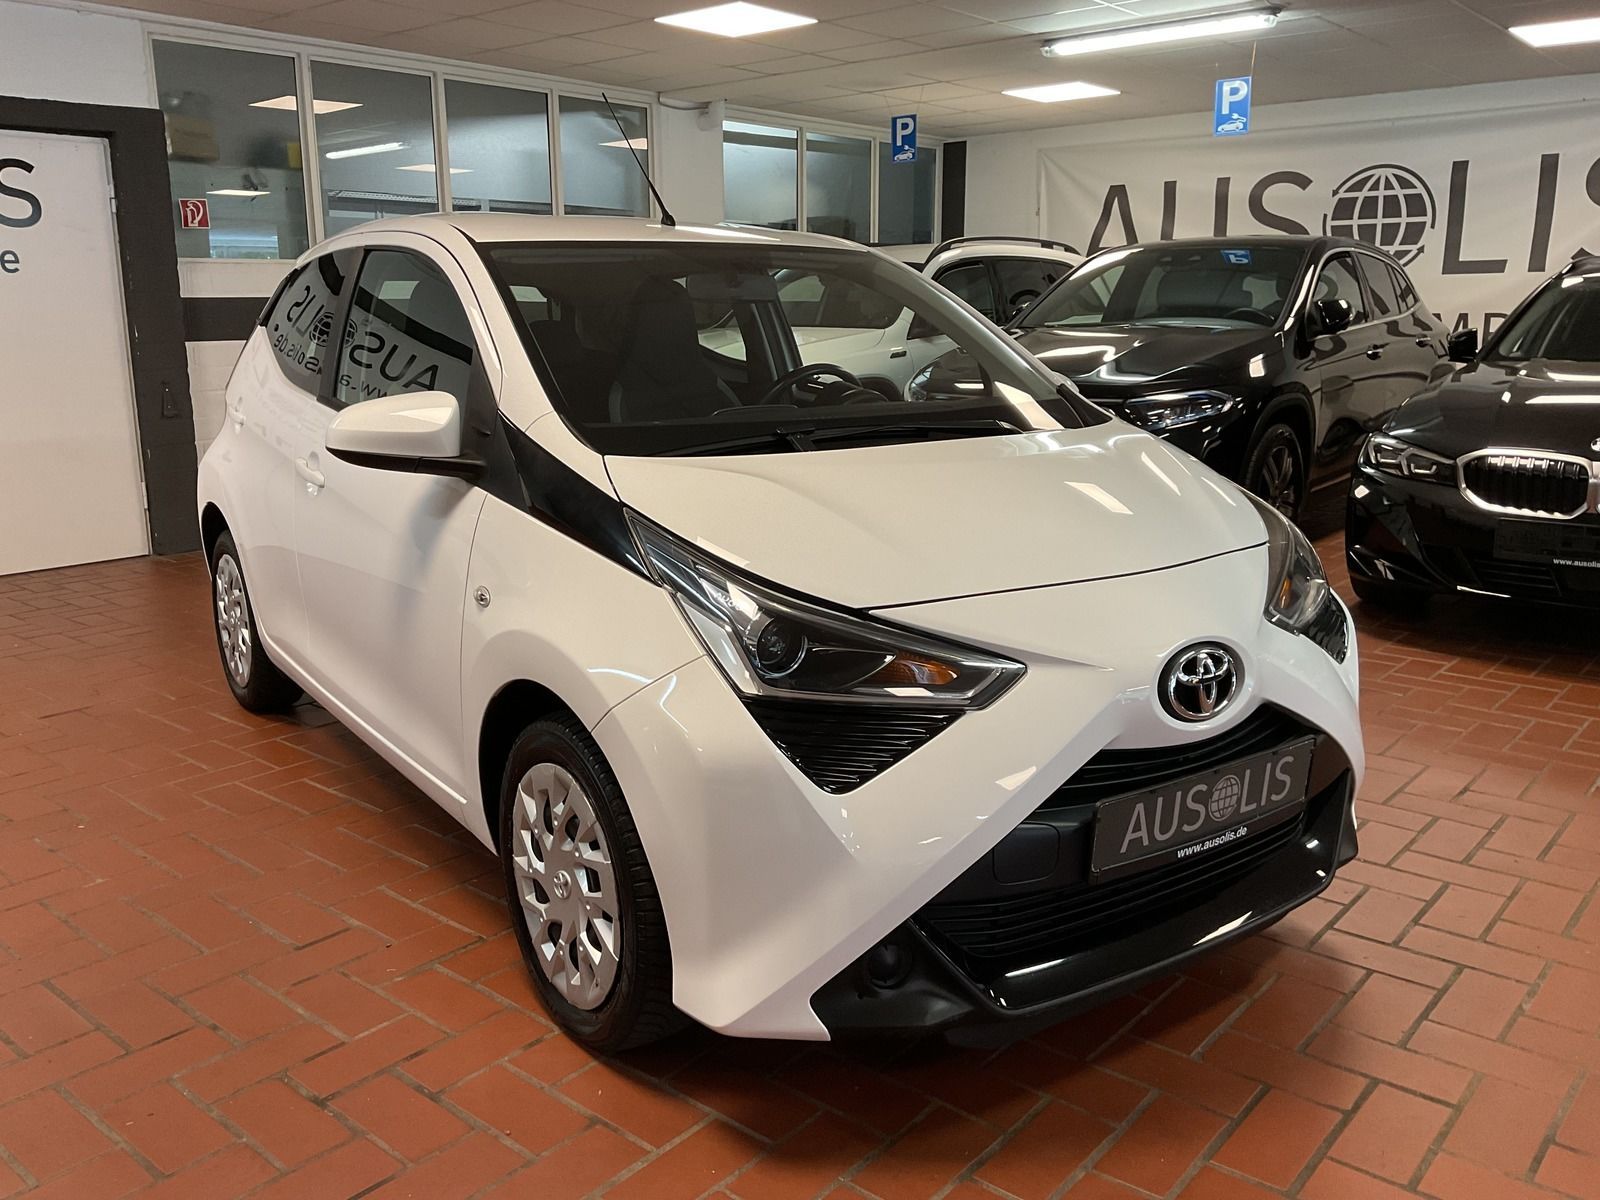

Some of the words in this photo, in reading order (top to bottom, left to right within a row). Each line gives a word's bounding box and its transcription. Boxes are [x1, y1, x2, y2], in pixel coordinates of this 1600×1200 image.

[1222, 80, 1248, 114] P
[896, 117, 914, 146] P
[1087, 153, 1600, 275] AUSOLI
[1120, 756, 1294, 854] AUSOLIS
[1177, 826, 1247, 858] www.ausolis.de
